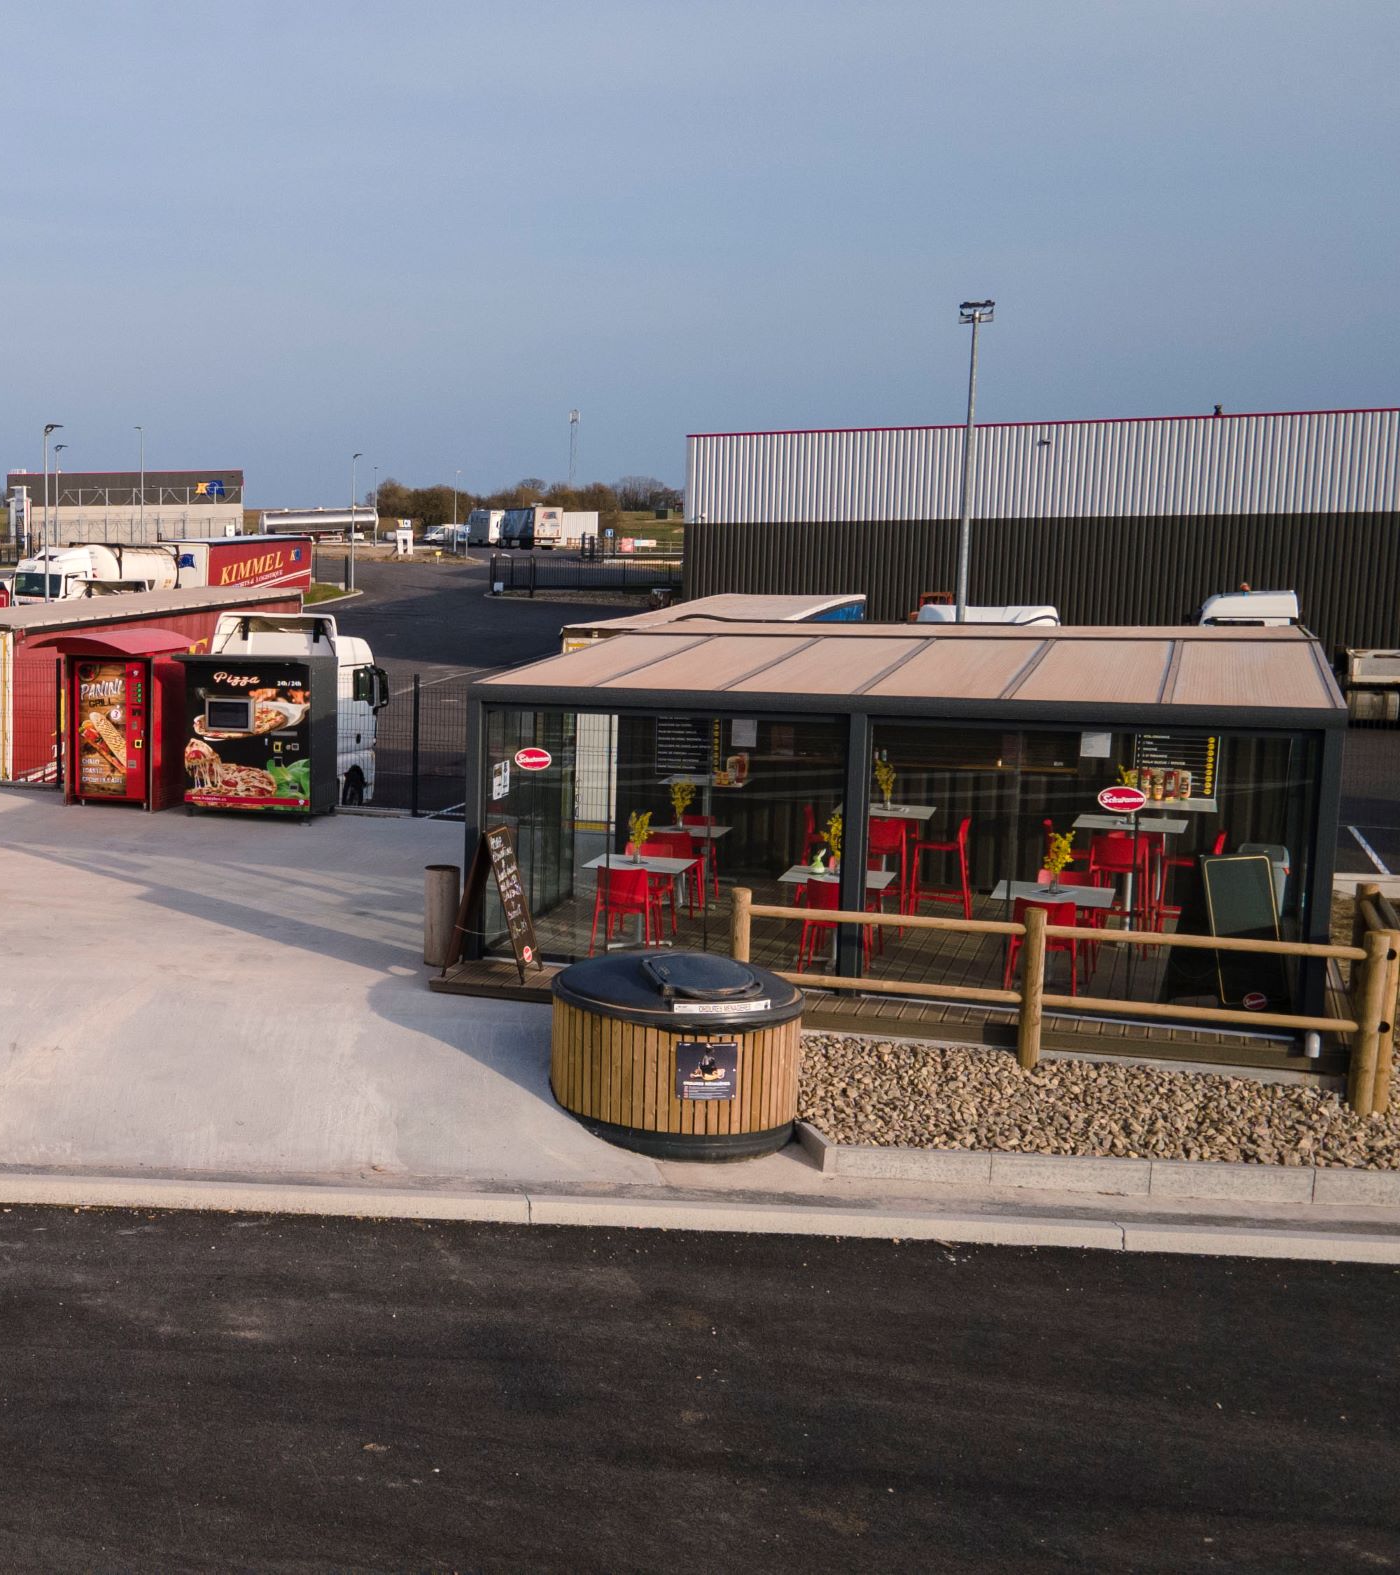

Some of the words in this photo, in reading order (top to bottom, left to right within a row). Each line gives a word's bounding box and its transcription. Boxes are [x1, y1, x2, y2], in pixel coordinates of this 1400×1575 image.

[220, 551, 284, 586] KIMMEL
[213, 671, 261, 687] Pizza
[80, 678, 122, 700] PANINI
[88, 698, 114, 708] GRILL
